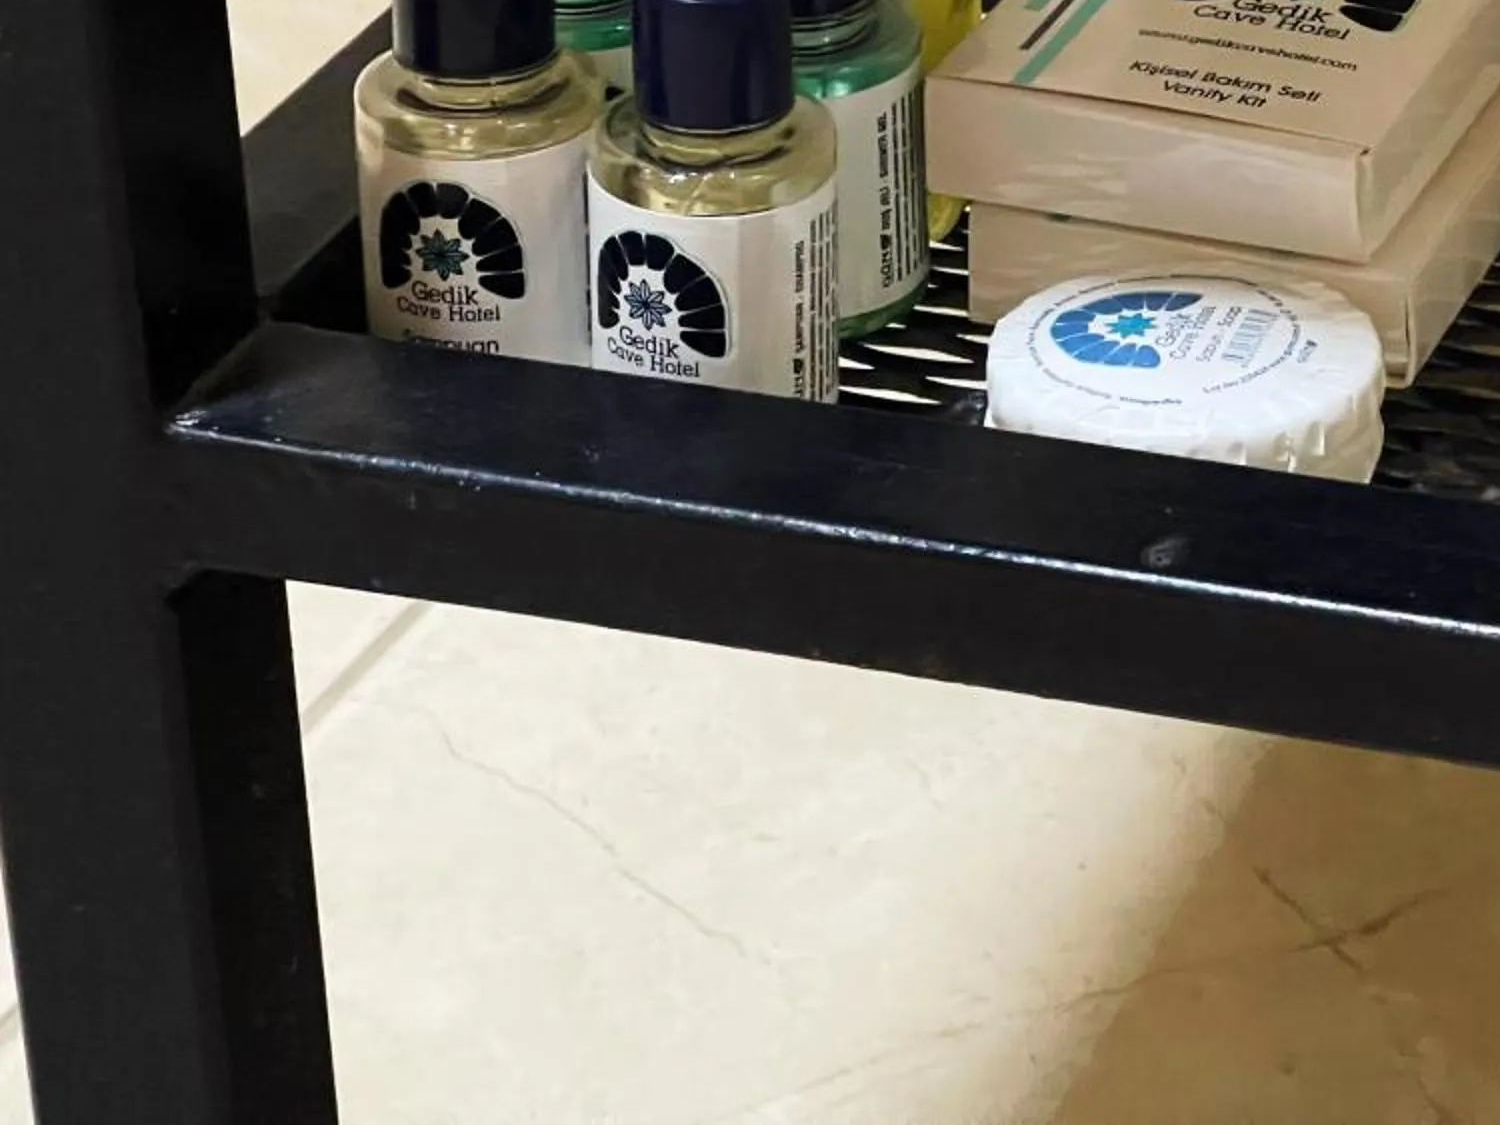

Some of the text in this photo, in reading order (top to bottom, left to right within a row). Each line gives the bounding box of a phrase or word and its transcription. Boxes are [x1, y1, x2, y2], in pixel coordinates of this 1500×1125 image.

[1193, 4, 1351, 41] Cave Hotel
[1163, 80, 1268, 109] Vanity Kit
[396, 295, 501, 323] Cave Hotel
[411, 281, 479, 306] Gedik
[607, 336, 700, 377] Cave Hotel
[619, 326, 679, 359] Gedik
